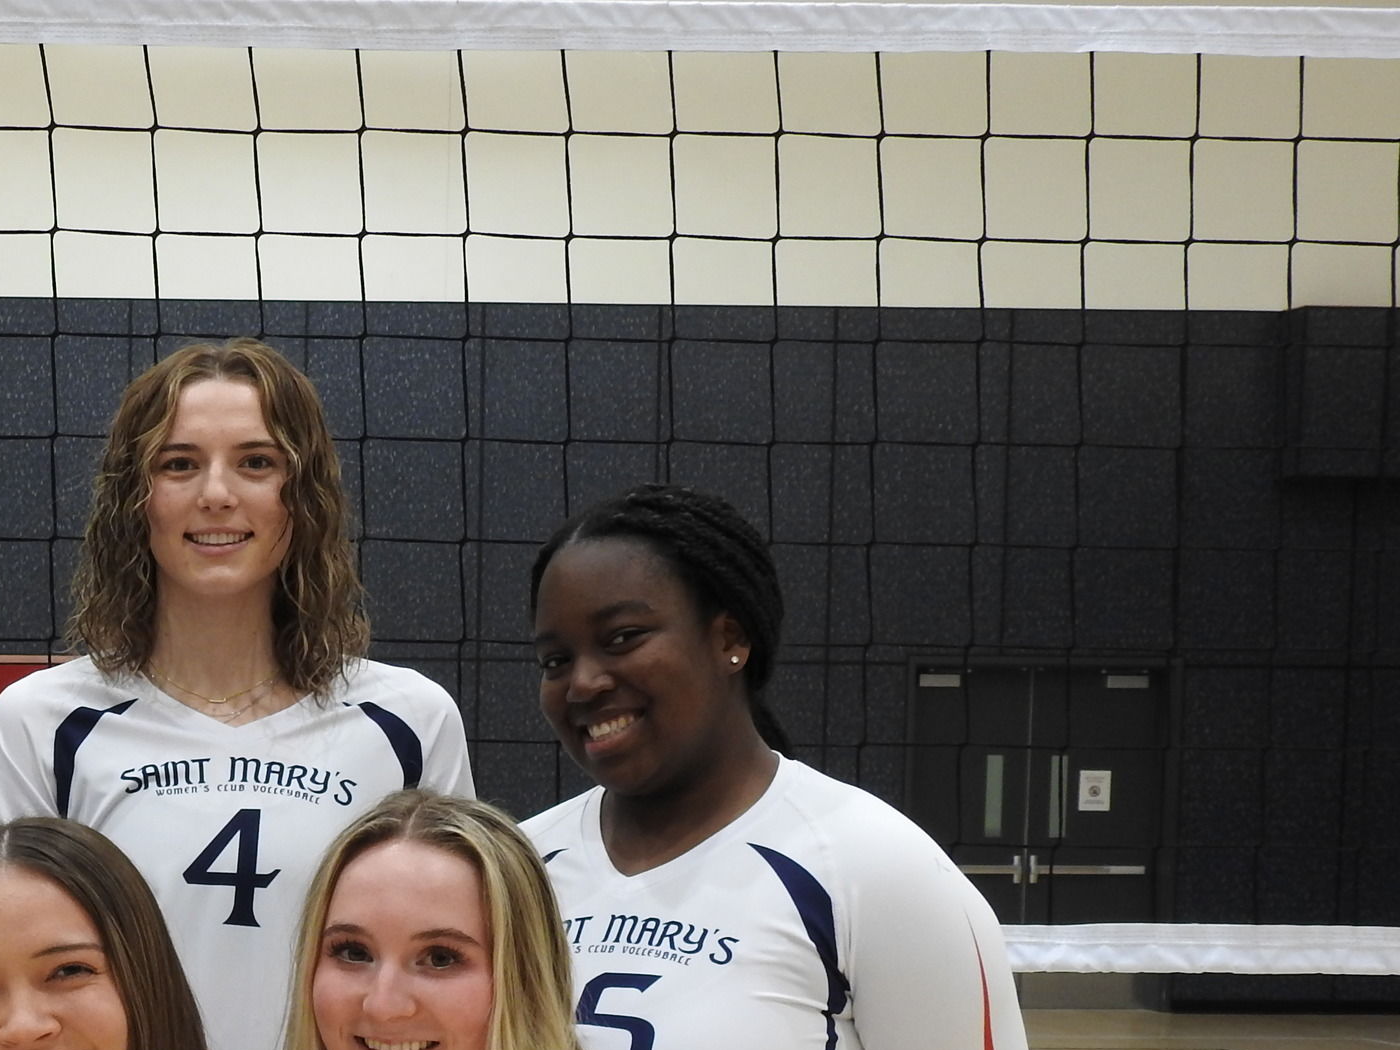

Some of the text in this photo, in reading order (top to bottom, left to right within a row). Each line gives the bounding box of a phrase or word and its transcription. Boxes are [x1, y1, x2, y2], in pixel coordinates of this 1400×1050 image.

[120, 756, 357, 806] SAINT MARY'S
[155, 783, 320, 805] WOMEN'S CLUB VOLLEYBALL
[182, 808, 282, 928] 4
[588, 944, 615, 954] CLUB
[622, 945, 692, 967] VOLLEYBALL
[601, 914, 740, 965] MARY'S
